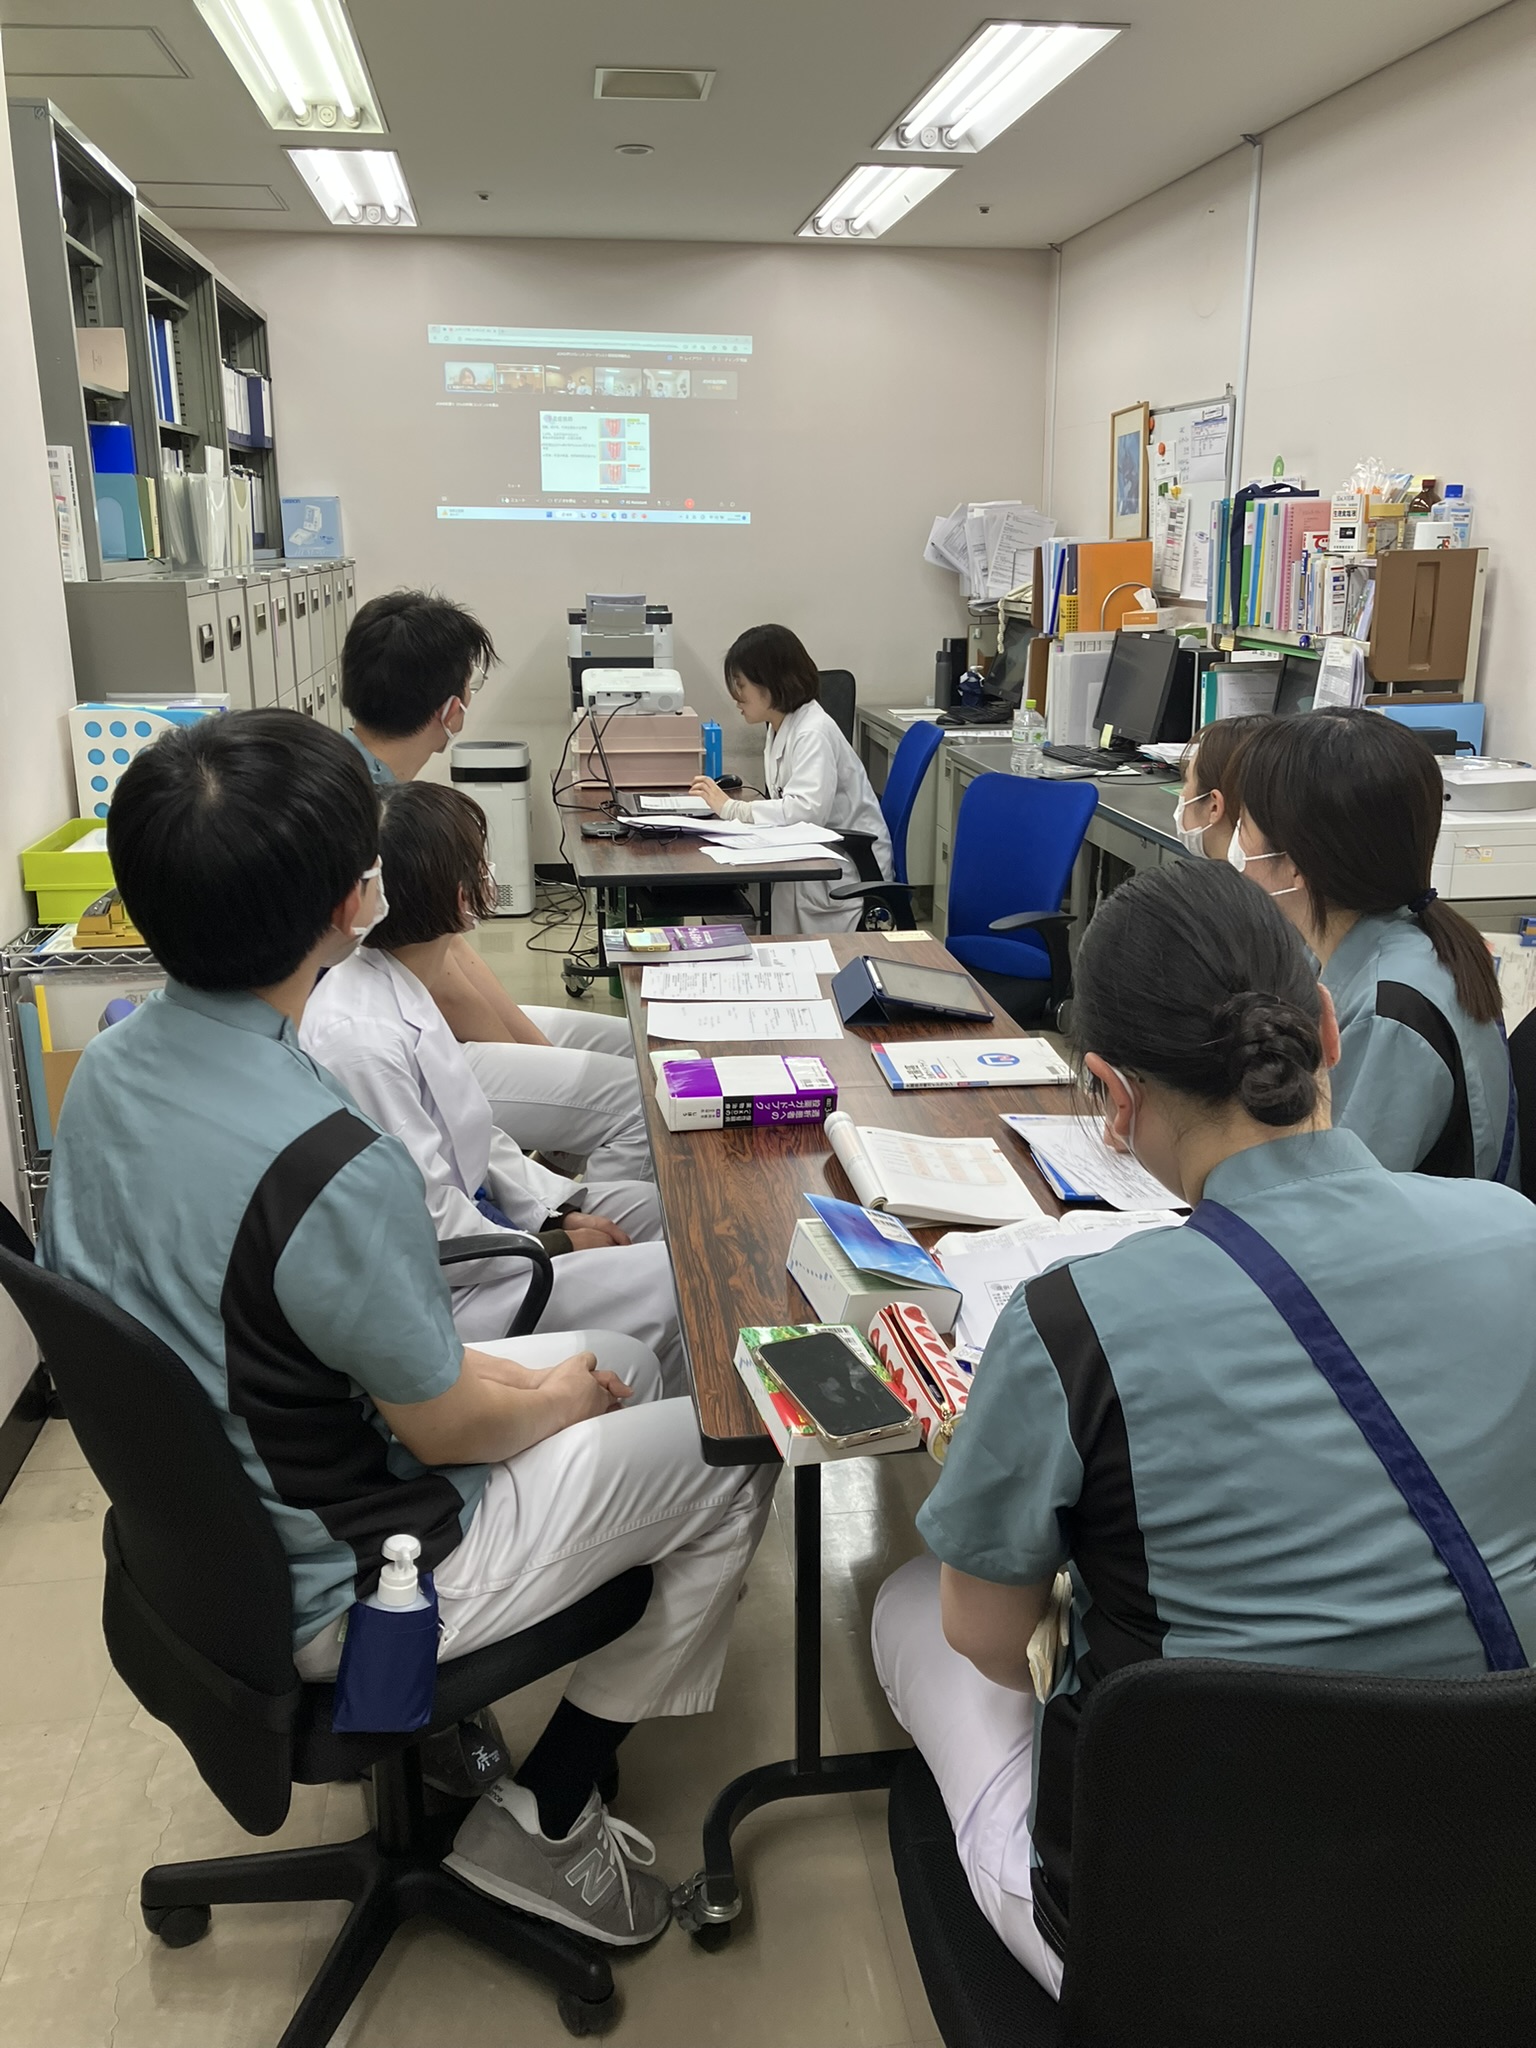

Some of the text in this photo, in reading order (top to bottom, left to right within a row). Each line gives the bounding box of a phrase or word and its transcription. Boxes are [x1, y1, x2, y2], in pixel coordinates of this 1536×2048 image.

[771, 1109, 821, 1121] 透析患者への
[564, 1847, 617, 1906] N
